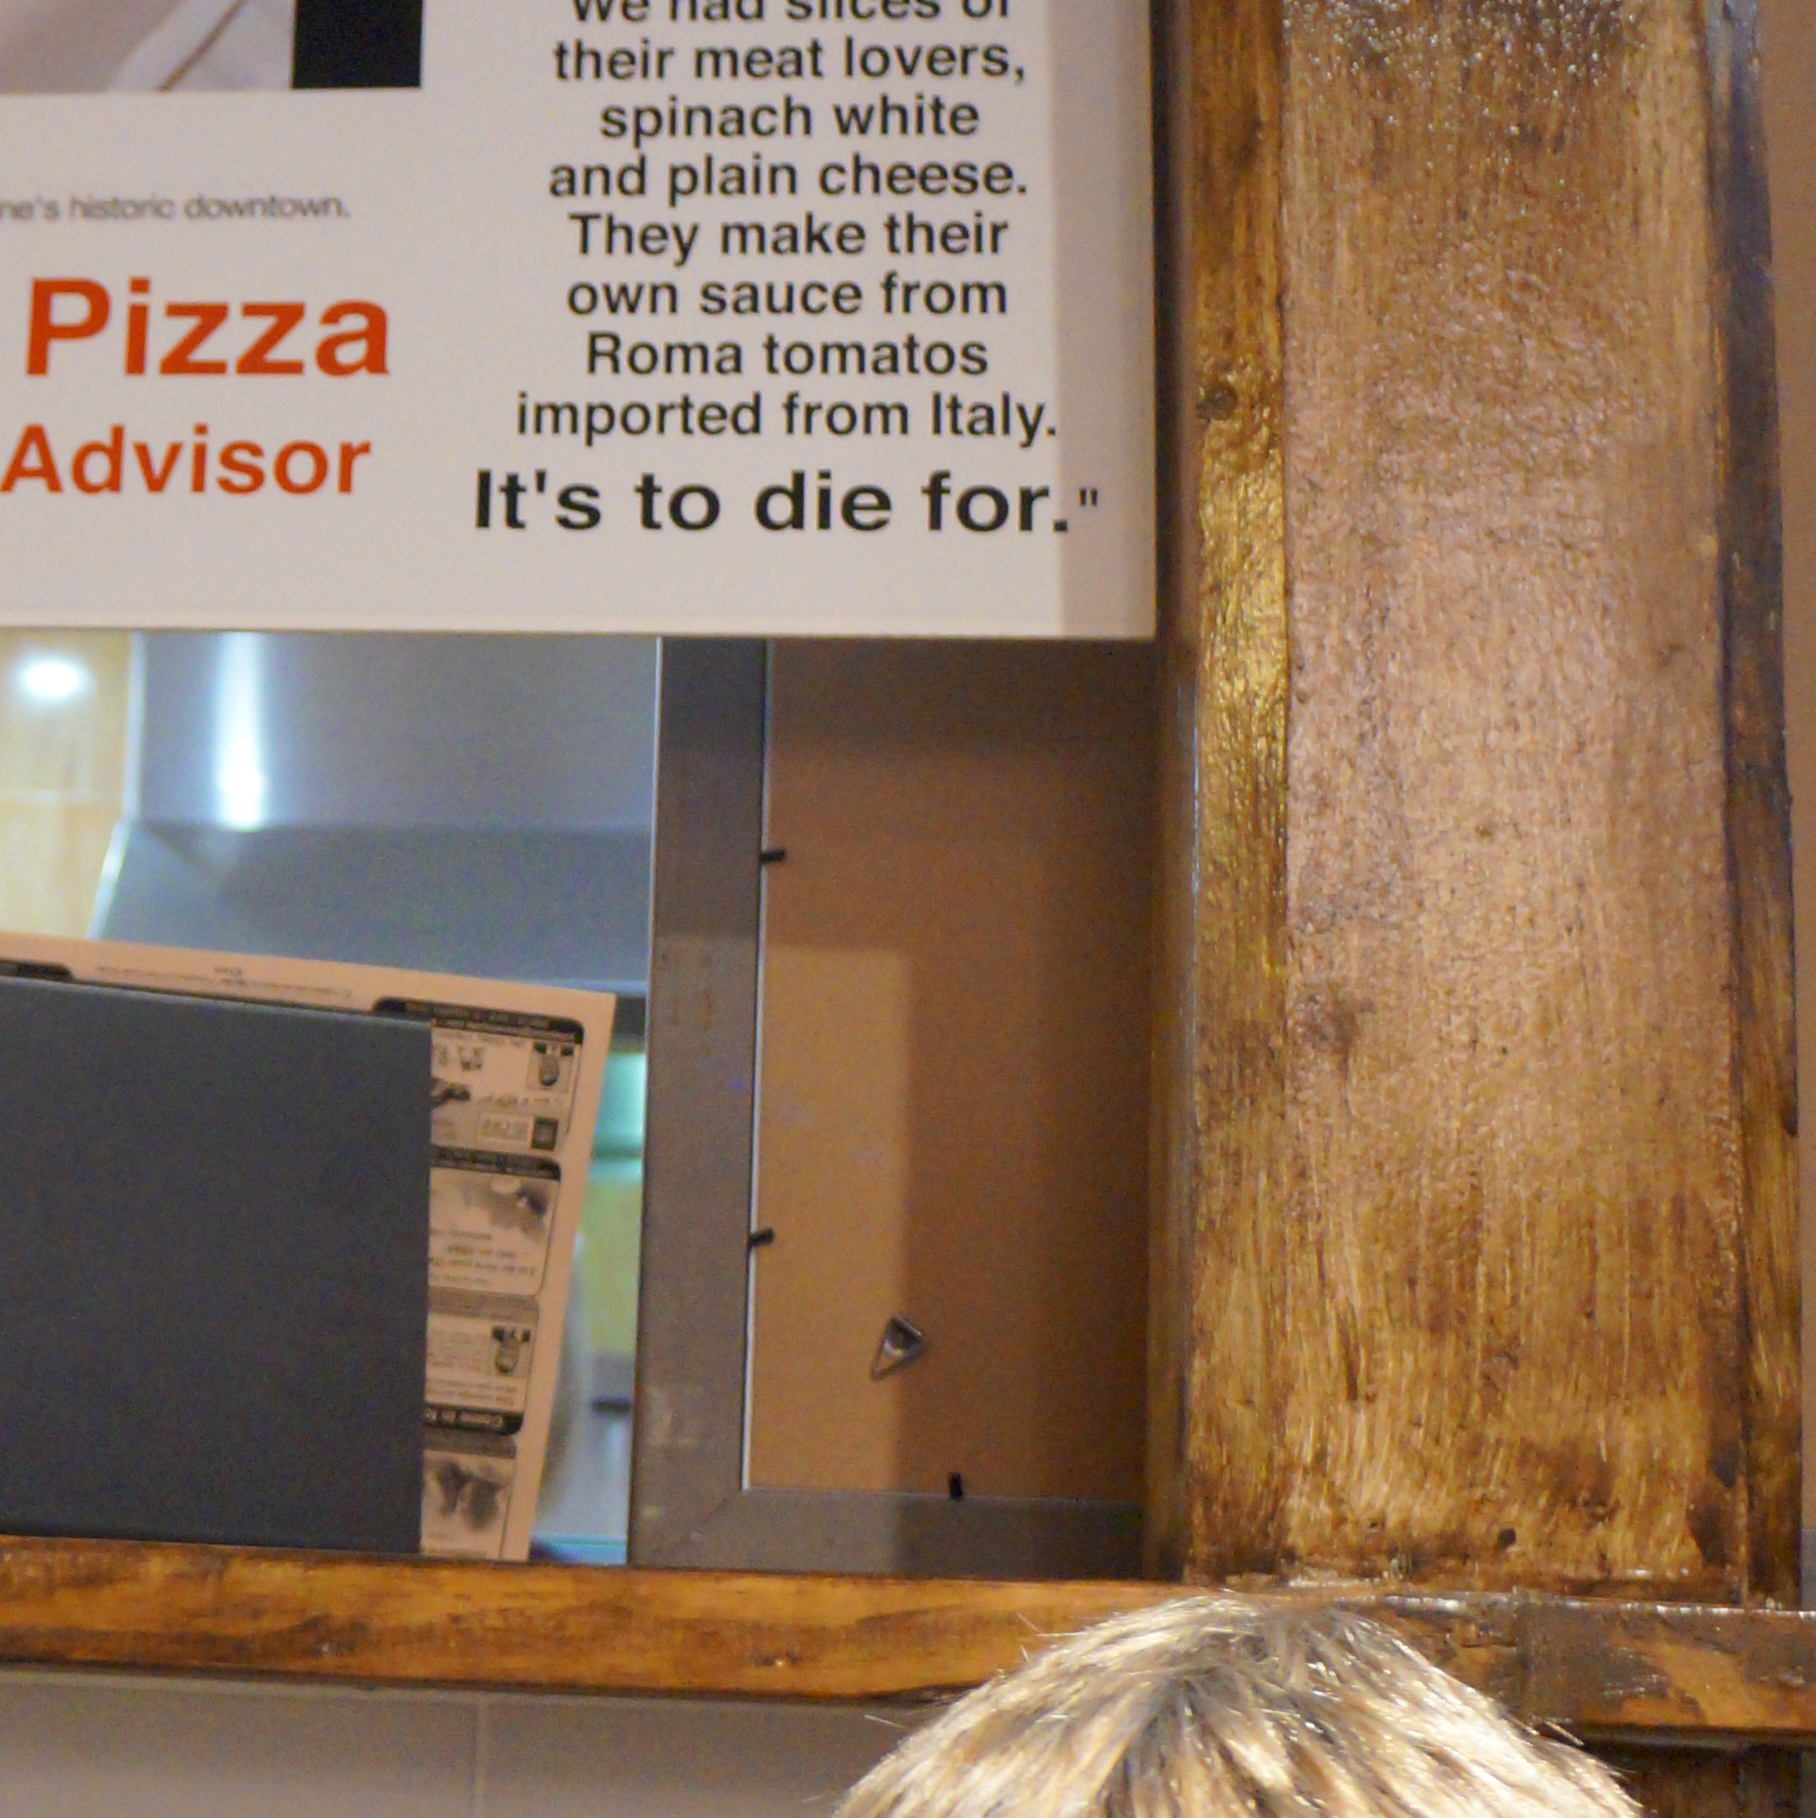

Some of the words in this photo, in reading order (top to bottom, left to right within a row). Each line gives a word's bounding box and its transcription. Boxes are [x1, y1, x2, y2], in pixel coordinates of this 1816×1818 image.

[553, 38, 675, 81] their
[694, 38, 823, 80] meat
[844, 35, 1025, 83] lovers,
[600, 94, 812, 150] spinach
[833, 93, 980, 137] white
[68, 192, 175, 222] historic
[183, 191, 351, 220] downtown.
[549, 153, 647, 198] and
[668, 152, 798, 209] plain
[818, 152, 1027, 197] cheese.
[568, 212, 700, 268] They
[720, 211, 867, 256] make
[884, 210, 1009, 256] their
[566, 282, 678, 317] own
[700, 281, 863, 316] sauce
[880, 270, 1007, 316] from
[26, 277, 389, 378] Pizza
[587, 331, 743, 376] Roma
[763, 333, 989, 377] tomatos
[517, 391, 762, 448] imported
[782, 391, 909, 437] from
[932, 391, 1057, 450] Italy.
[475, 469, 602, 531] It's
[634, 473, 721, 532] to
[754, 470, 892, 533] die
[921, 470, 1100, 534] for."
